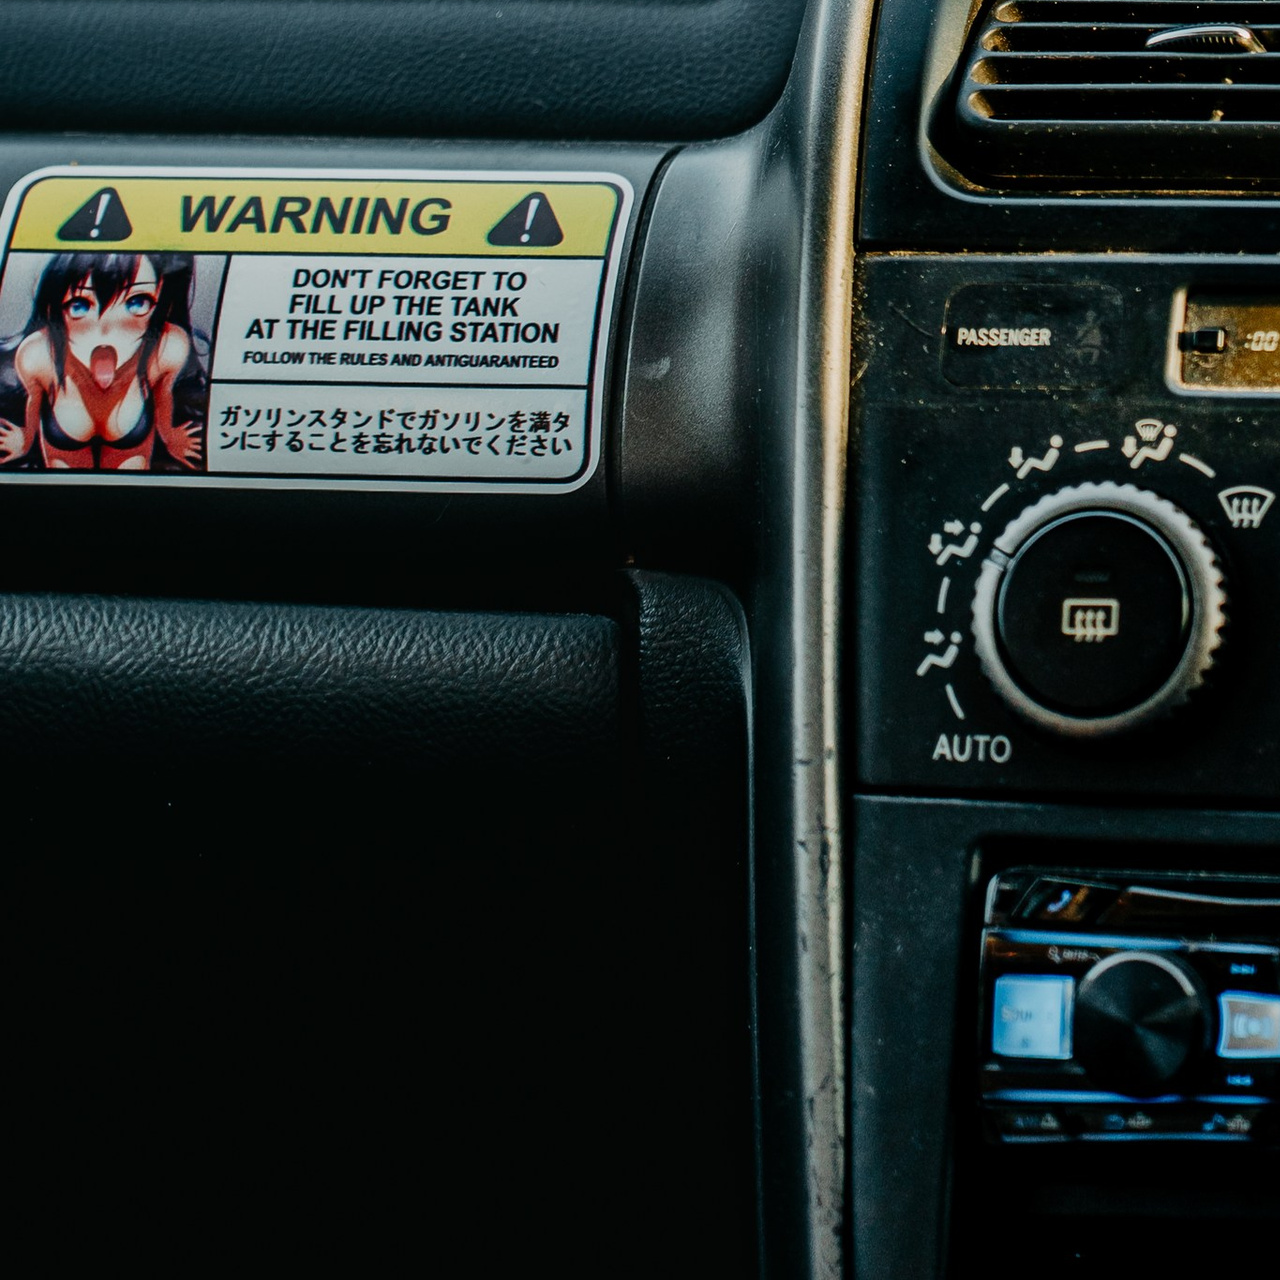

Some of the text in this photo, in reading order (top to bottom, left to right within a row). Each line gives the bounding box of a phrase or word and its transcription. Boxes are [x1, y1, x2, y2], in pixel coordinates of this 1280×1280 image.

[180, 195, 453, 236] WARNING
[292, 268, 528, 291] DON'T FORGET TO
[288, 294, 522, 317] FILL UP THE TANK
[245, 319, 561, 344] AT THE FILLING STATION
[957, 327, 1052, 347] PASSENGER
[243, 351, 560, 369] FOLLOW THE RULES AND ANTIGUARANTEED
[219, 405, 572, 434] ガソリンスタンドでガソリンを満タ
[219, 430, 573, 457] ンにすることを忘れないでください
[932, 733, 1013, 763] AUTO
